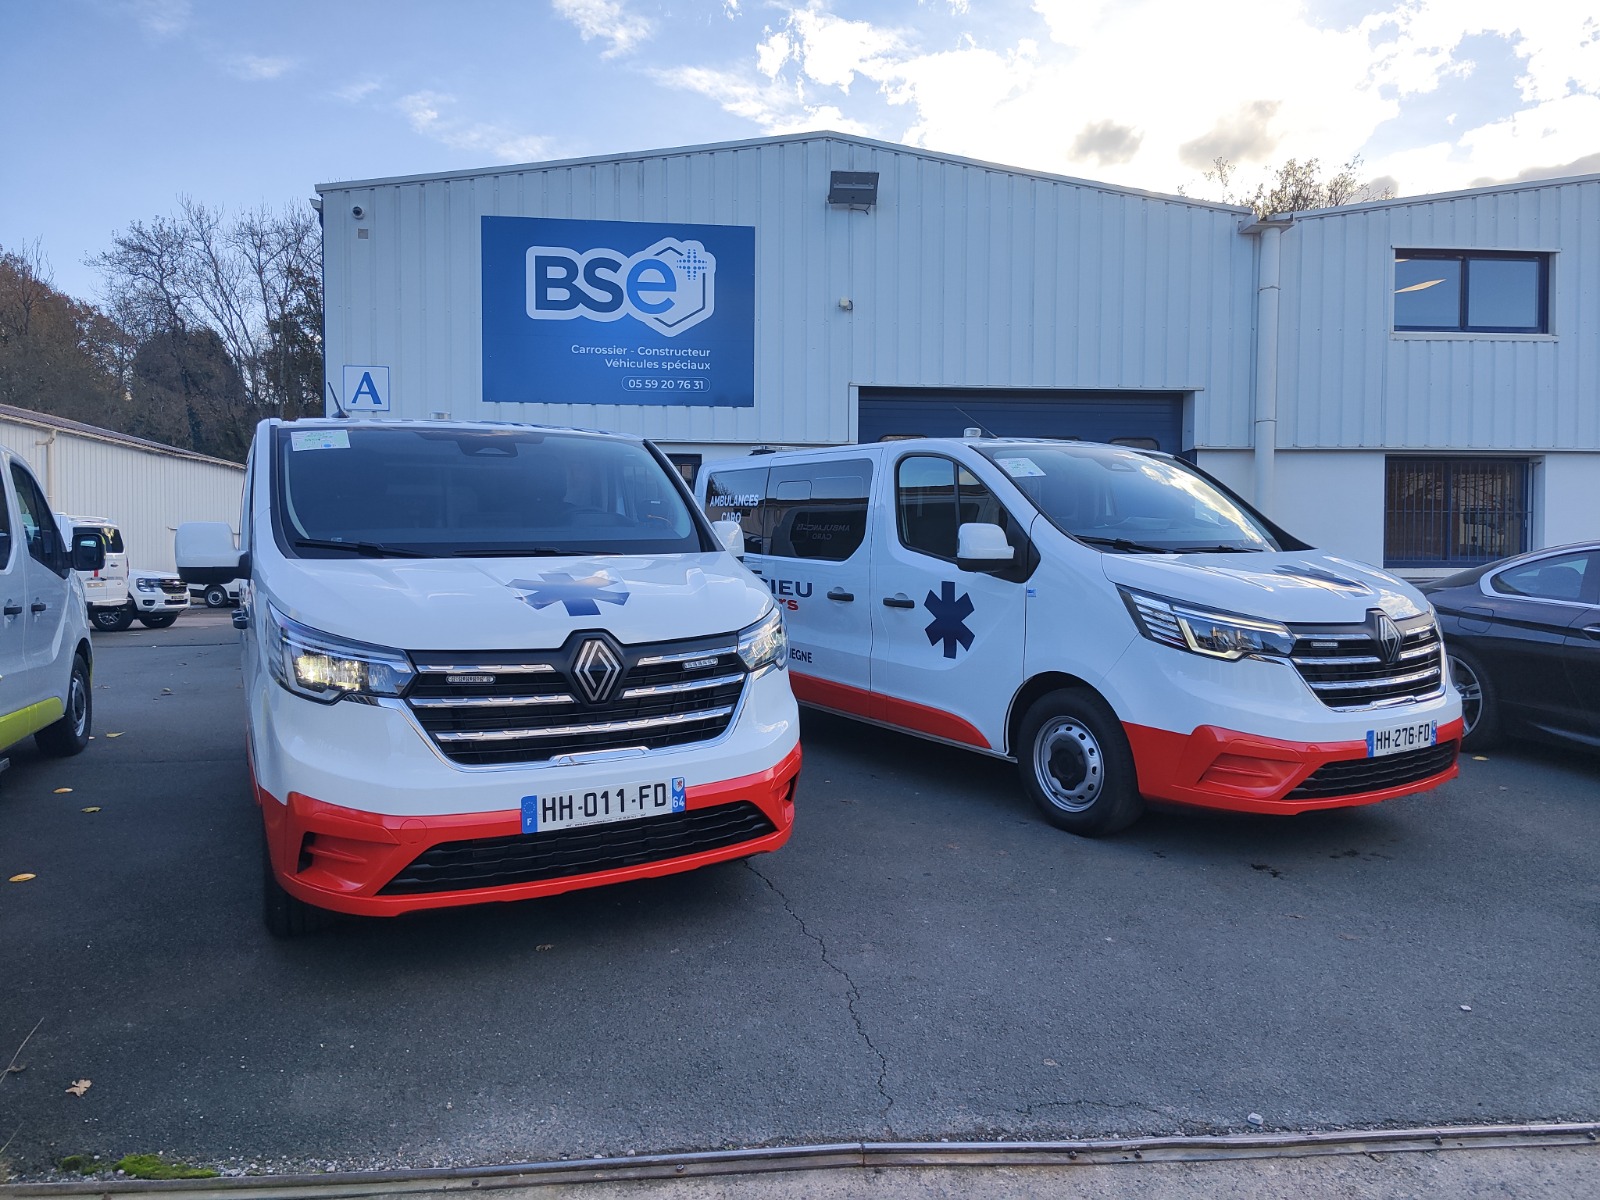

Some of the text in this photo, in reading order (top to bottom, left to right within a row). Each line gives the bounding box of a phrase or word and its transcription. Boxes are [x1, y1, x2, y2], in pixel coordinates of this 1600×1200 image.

[571, 345, 628, 355] Carrossier
[637, 347, 711, 357] Constructeur
[605, 358, 711, 372] Véhicules spéciaux
[351, 372, 382, 405] A
[628, 379, 704, 390] 05 59 20 76 31
[709, 494, 759, 507] AMBULANCES
[721, 512, 742, 523] CARO
[542, 783, 666, 823] HH-011-FD
[673, 795, 684, 808] 64
[527, 818, 532, 826] F
